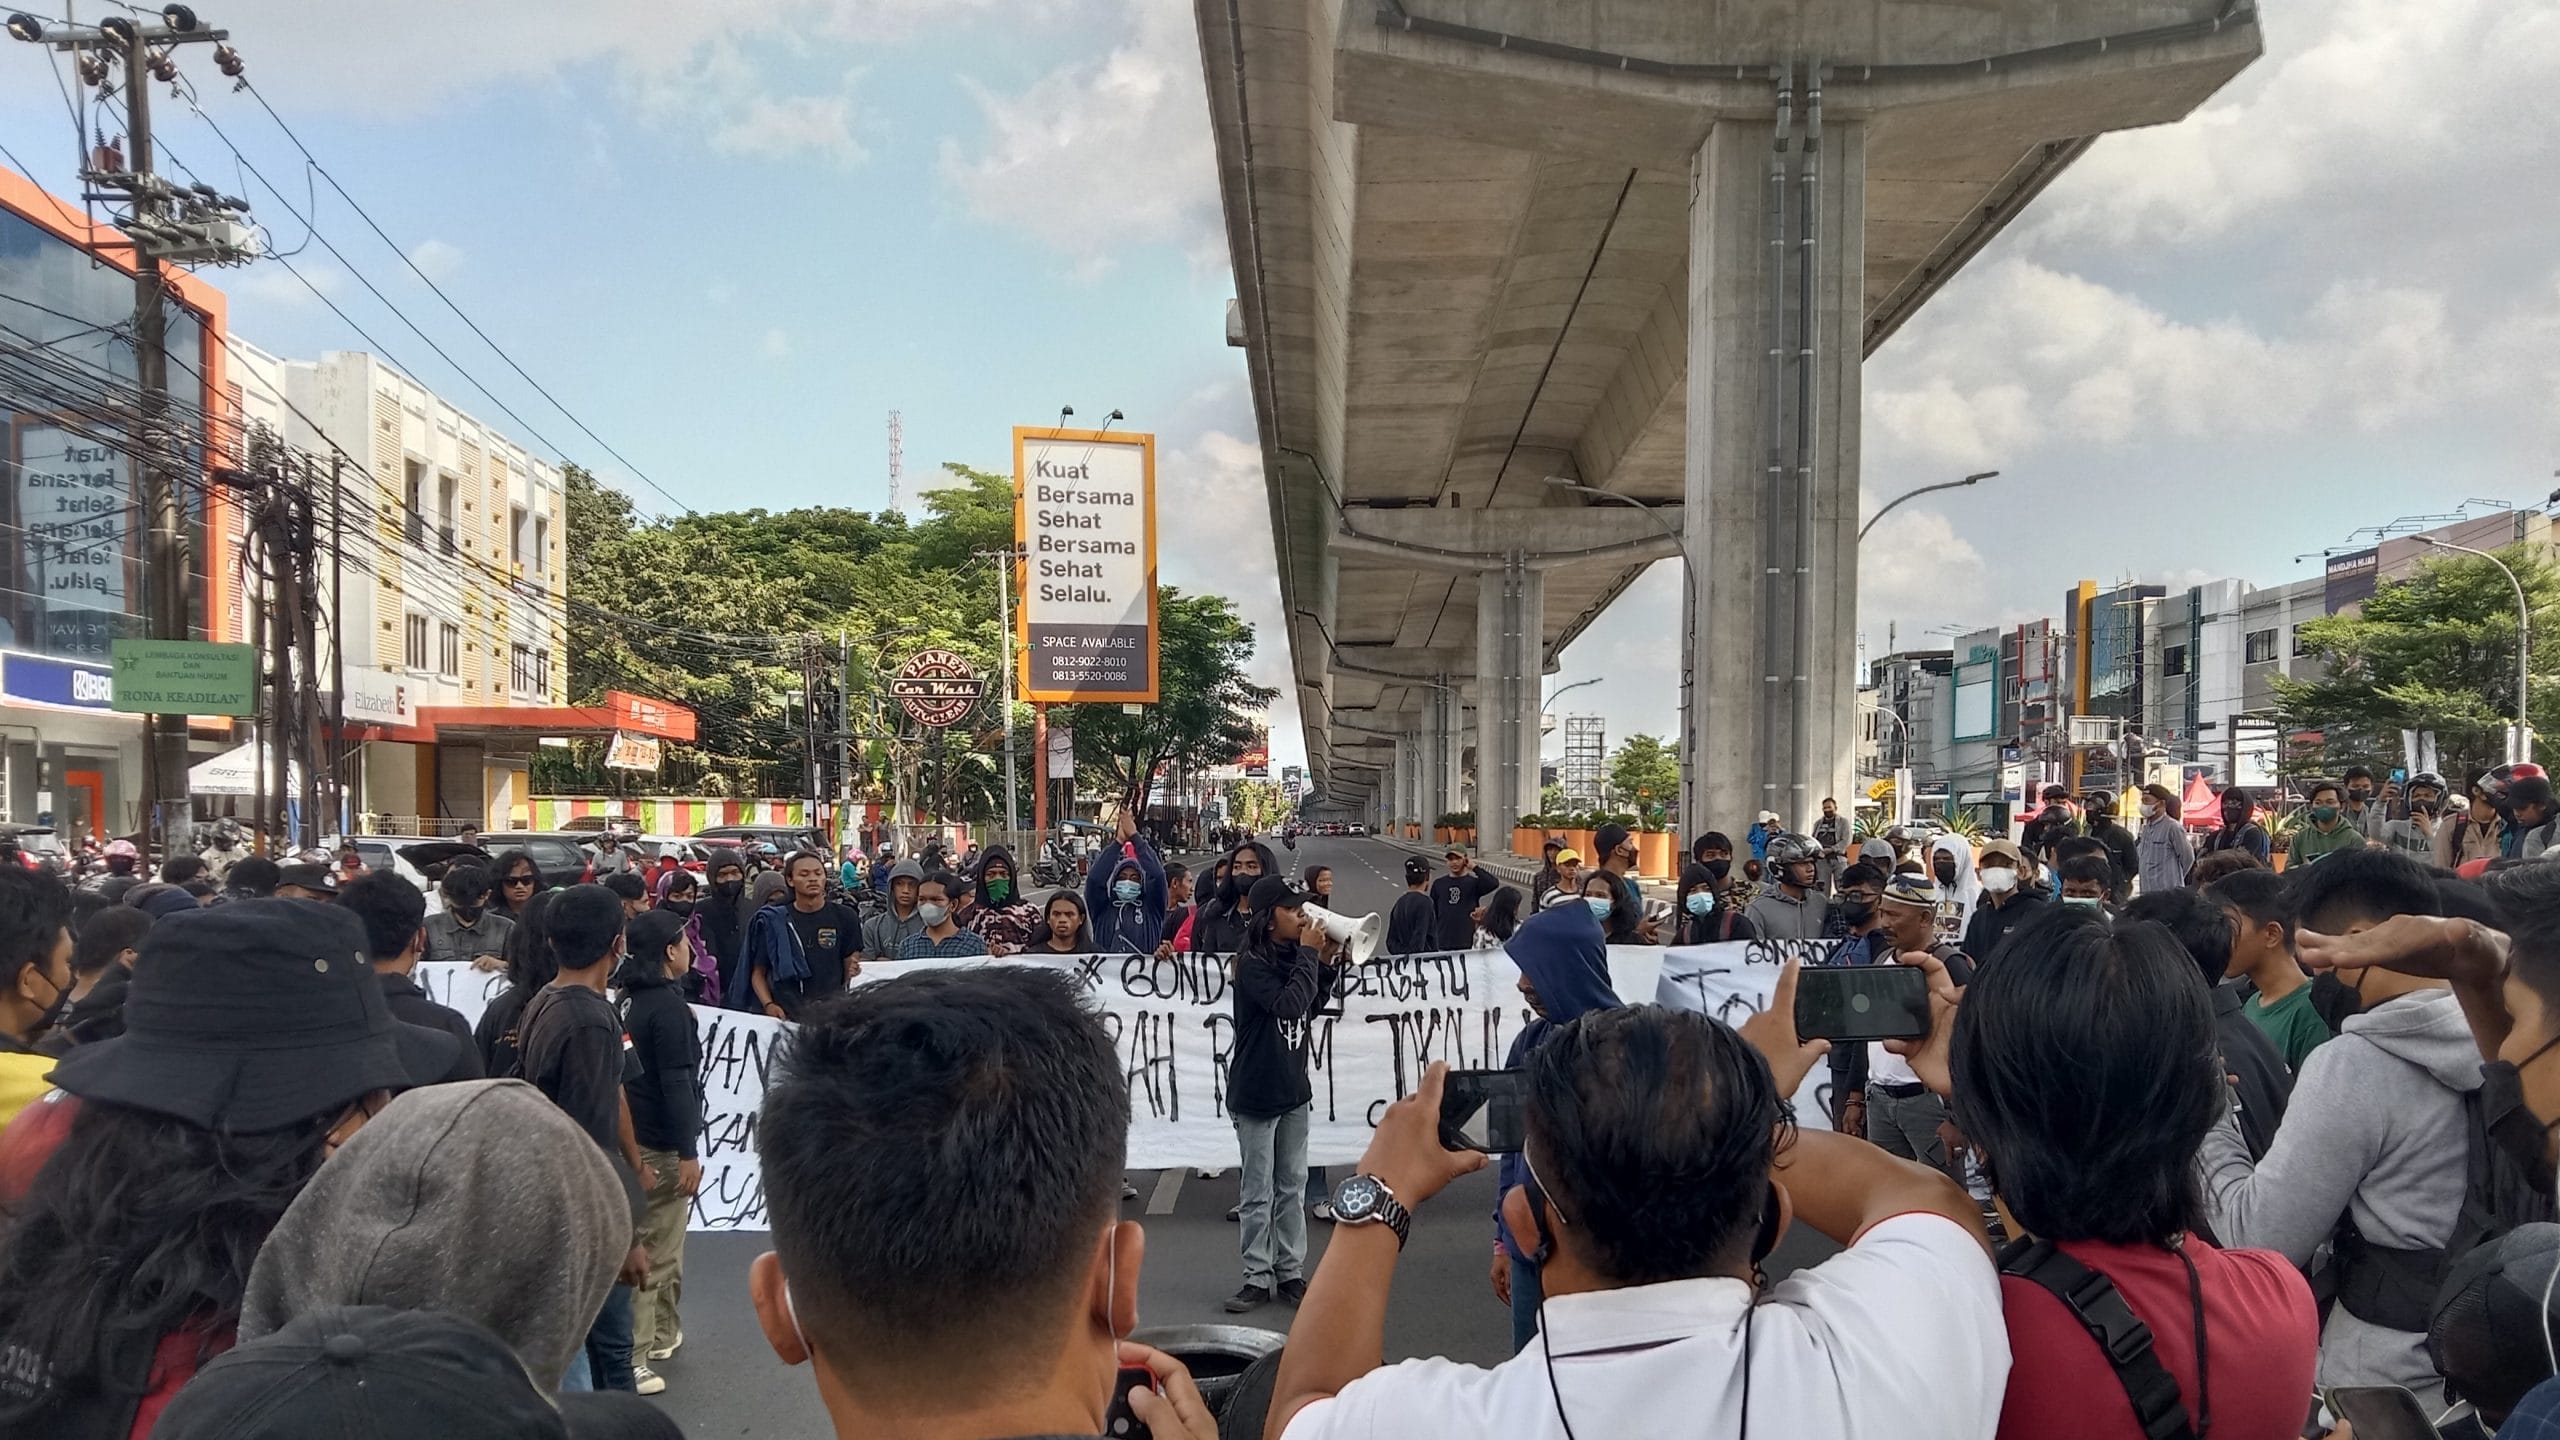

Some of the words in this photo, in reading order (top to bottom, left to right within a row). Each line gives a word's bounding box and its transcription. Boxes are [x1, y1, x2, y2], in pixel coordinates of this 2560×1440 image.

[1036, 460, 1090, 480] Kuat
[1037, 485, 1134, 506] Bersama
[1038, 509, 1102, 529] Sehat
[1039, 534, 1135, 555] Bersama
[1040, 559, 1103, 578] Sehat
[1040, 583, 1112, 603] Selalu.
[1042, 636, 1077, 648] SPACE
[1081, 637, 1136, 649] AVAILABLE
[188, 653, 239, 661] KONSULTASI
[906, 652, 967, 677] PLANET
[1052, 656, 1127, 668] 0812-9022-8010
[156, 671, 195, 679] BANTUAN
[198, 672, 228, 680] HUKUM
[1052, 670, 1128, 681] 0813-5520-0086
[893, 682, 926, 695] Car
[930, 682, 977, 695] Wash
[355, 691, 396, 715] Elizabeth
[905, 698, 968, 723] AUTOCLEAN
[1331, 953, 1469, 1002] BERSATU
